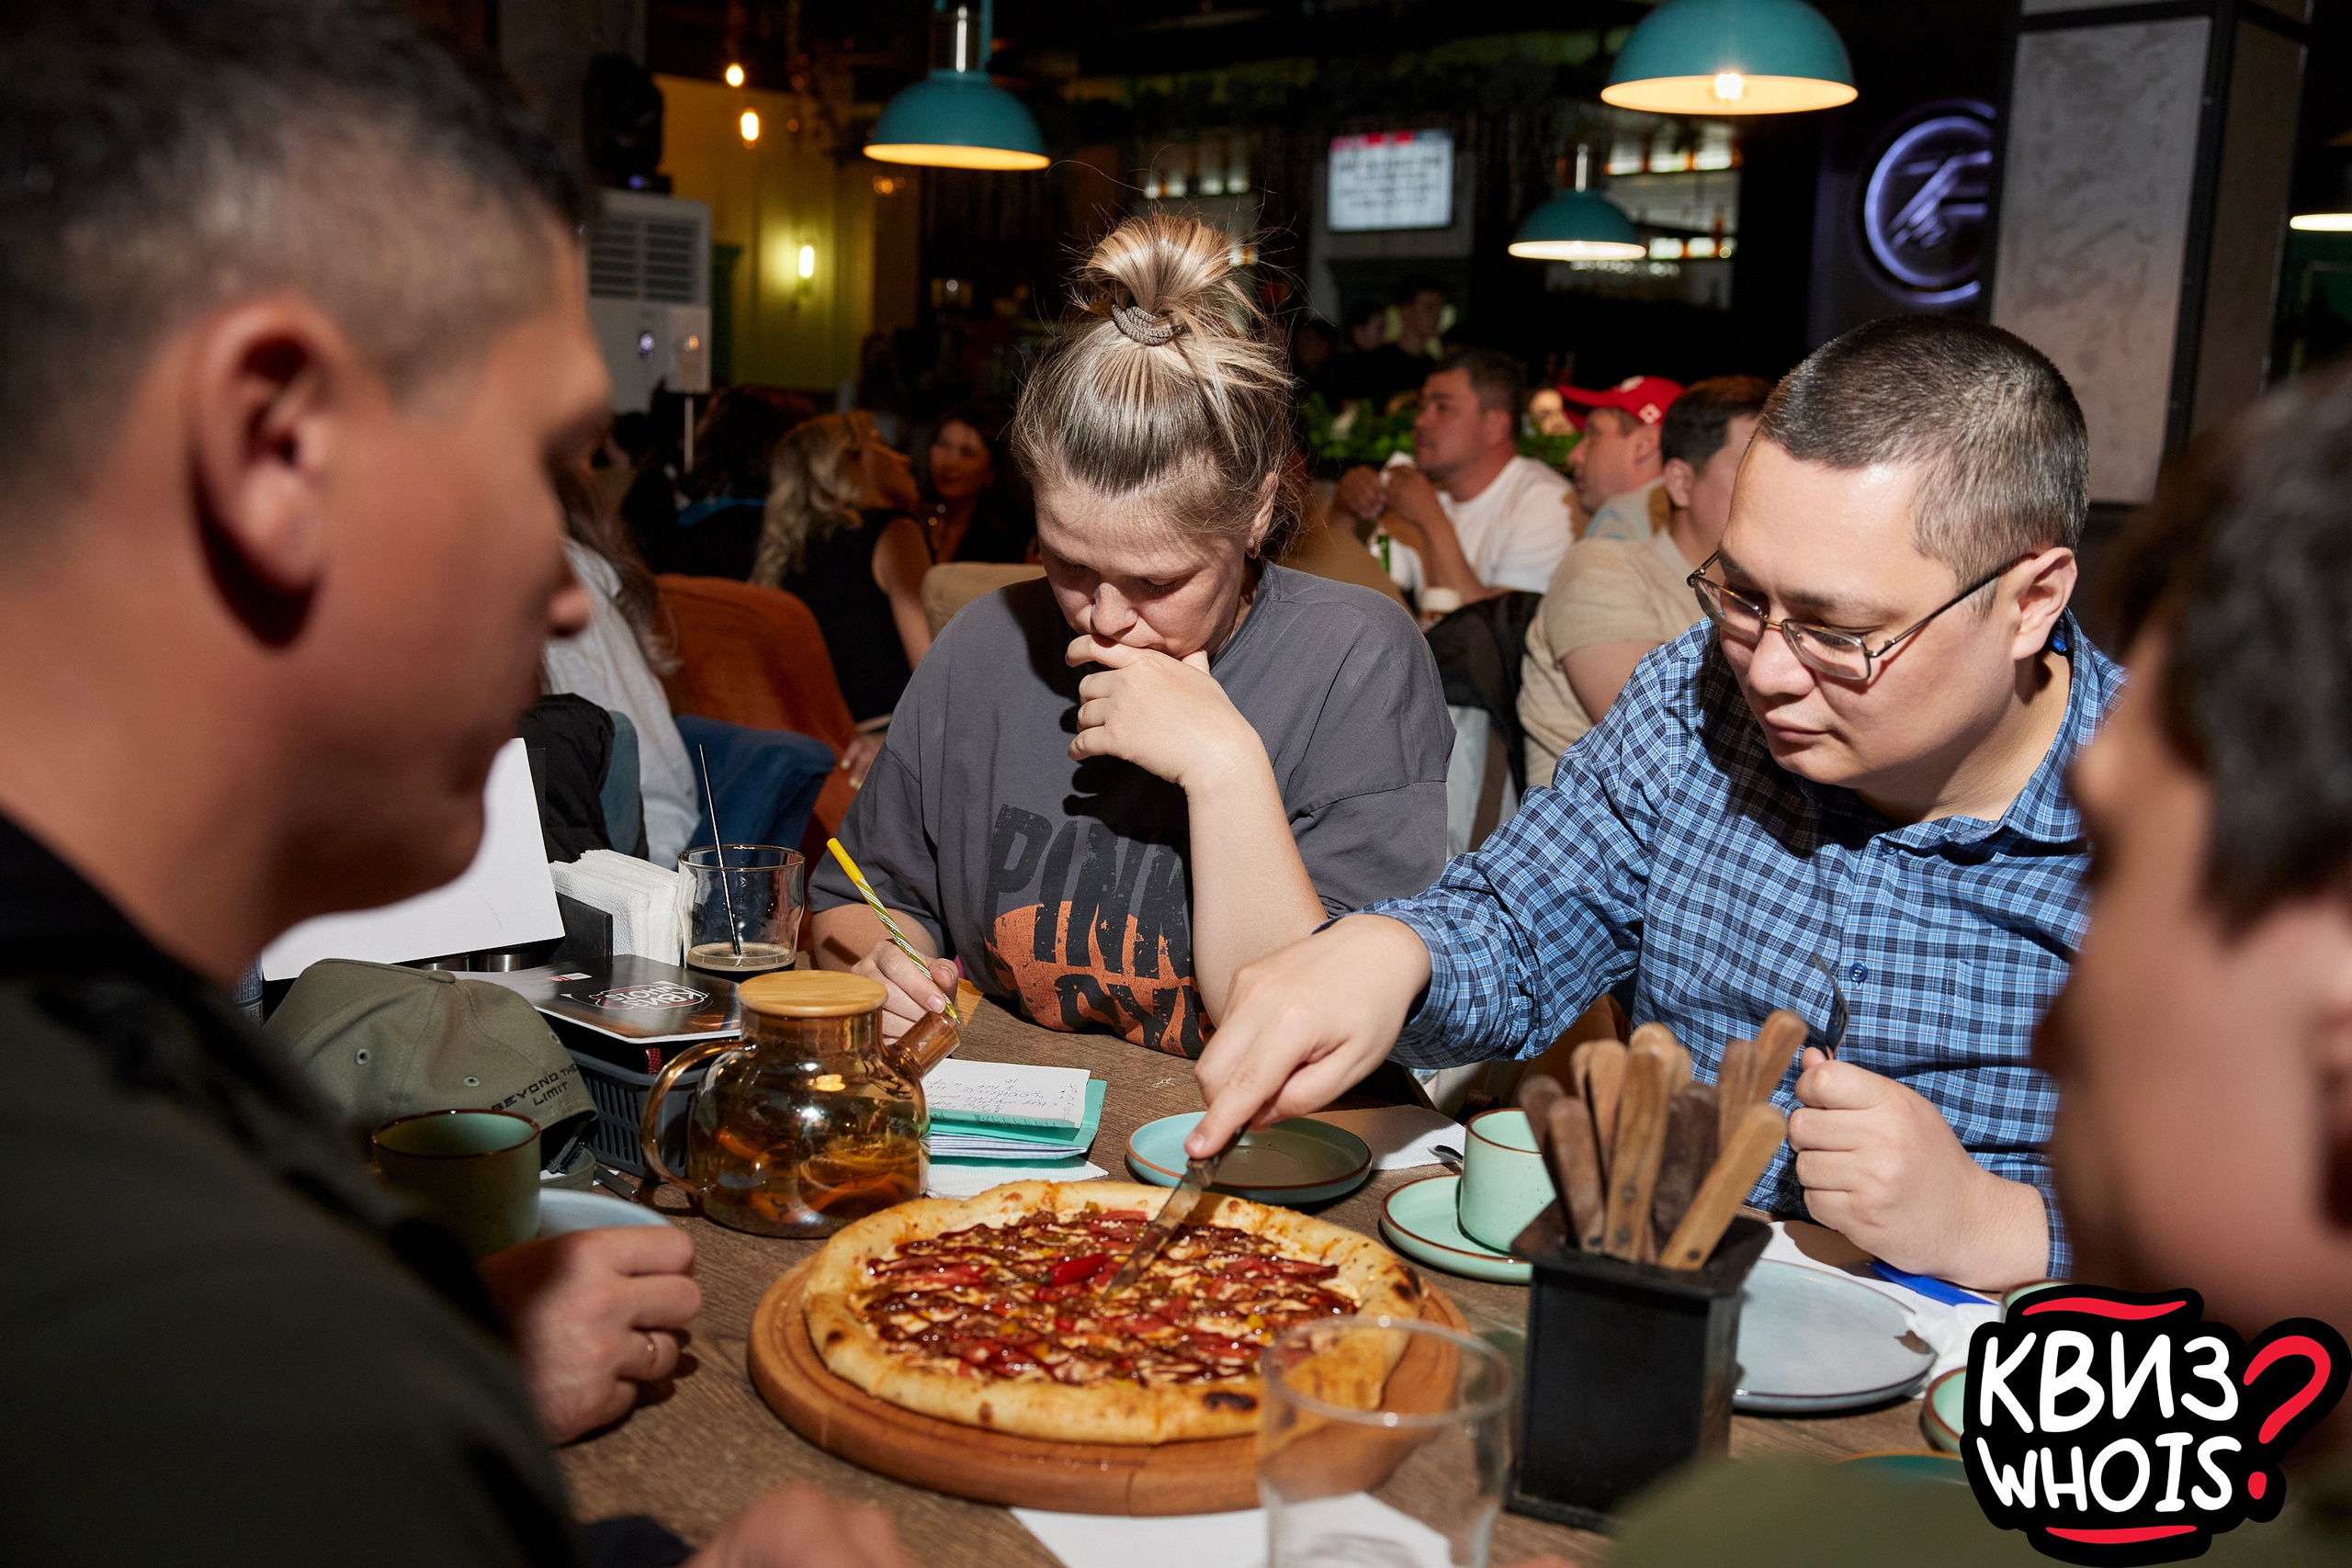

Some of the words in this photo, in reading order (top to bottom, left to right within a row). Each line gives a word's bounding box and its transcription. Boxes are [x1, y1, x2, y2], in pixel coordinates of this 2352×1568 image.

[982, 803, 1195, 979] PINK
[621, 989, 702, 1008] КВИЗ
[491, 1072, 560, 1111] BEYOND
[560, 1063, 578, 1077] THE
[533, 1081, 568, 1106] LIMIT
